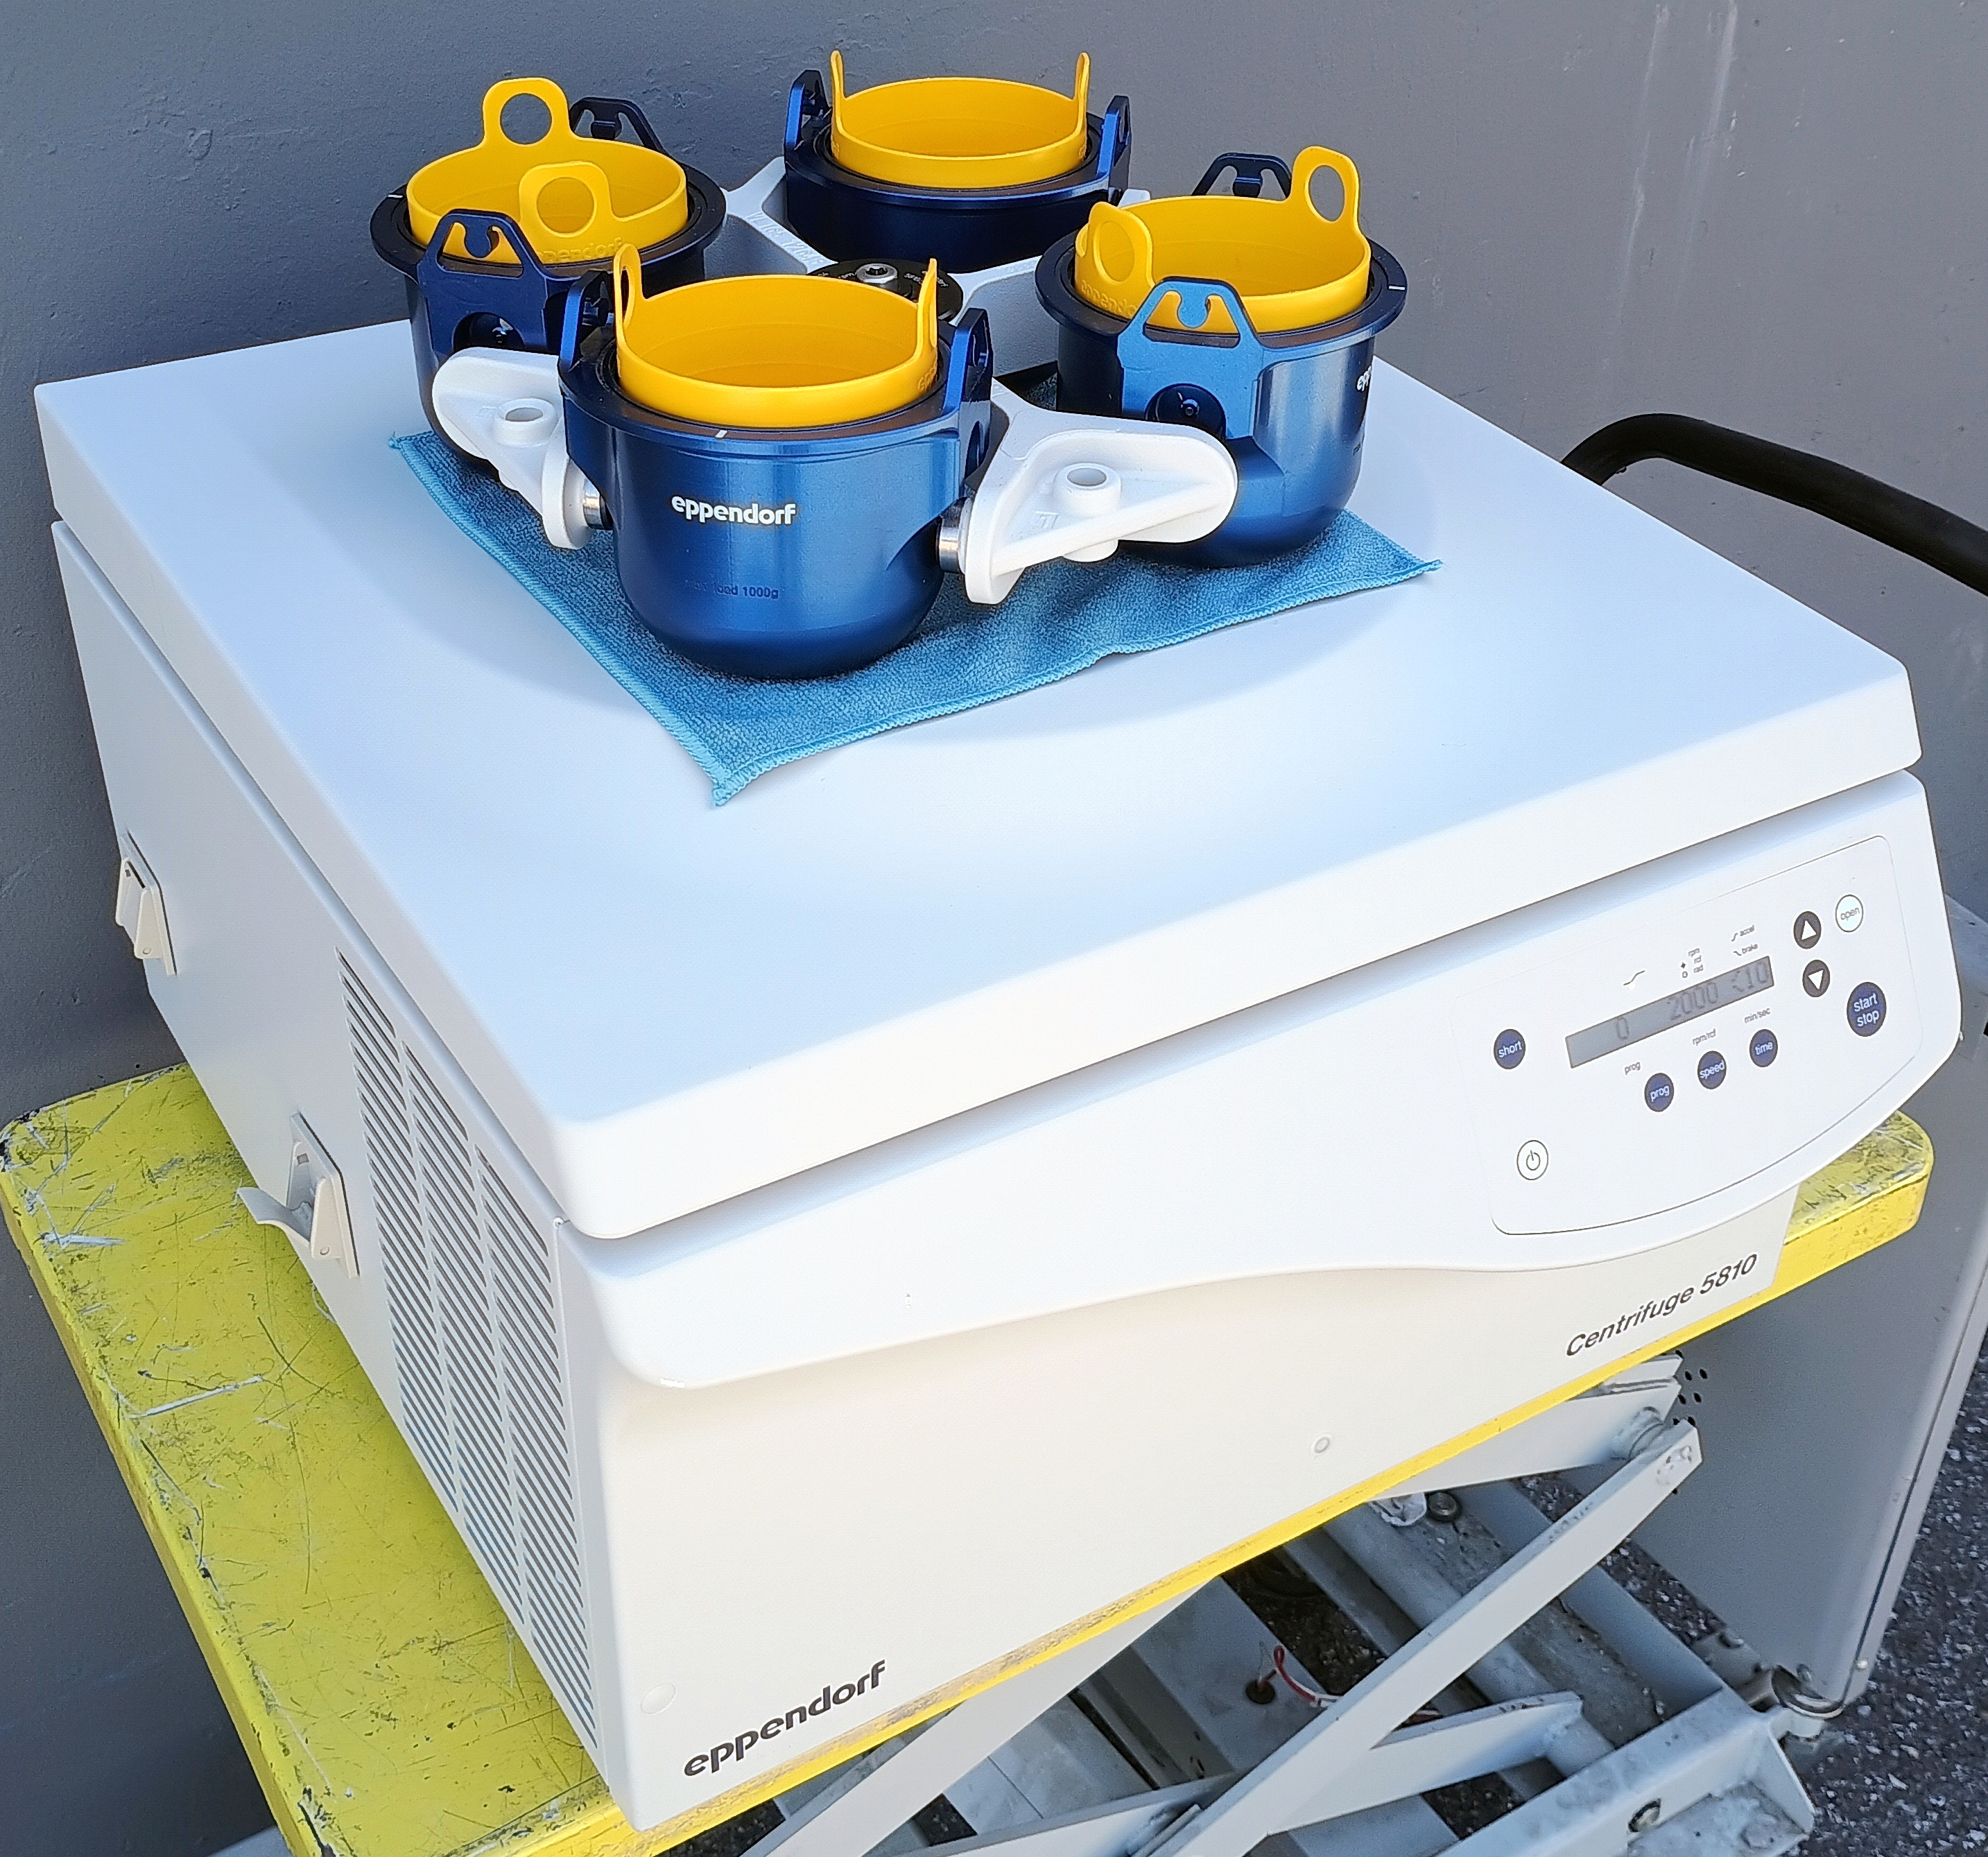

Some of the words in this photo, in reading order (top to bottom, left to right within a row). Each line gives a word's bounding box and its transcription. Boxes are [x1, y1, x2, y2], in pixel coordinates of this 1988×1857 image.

[671, 496, 796, 525] eppendorf
[742, 586, 779, 600] 1000g
[1841, 908, 1860, 920] open
[1666, 983, 1718, 1020] 2000
[1854, 993, 1878, 1012] start
[1858, 1010, 1879, 1026] stop
[1498, 1040, 1523, 1058] short
[1756, 1042, 1773, 1055] time
[1624, 1061, 1641, 1076] prog
[1700, 1060, 1725, 1079] speed
[1650, 1085, 1670, 1103] prog
[1566, 1287, 1694, 1356] Centrifuge
[1700, 1254, 1758, 1295] 5810
[684, 1659, 885, 1776] eppendorf
